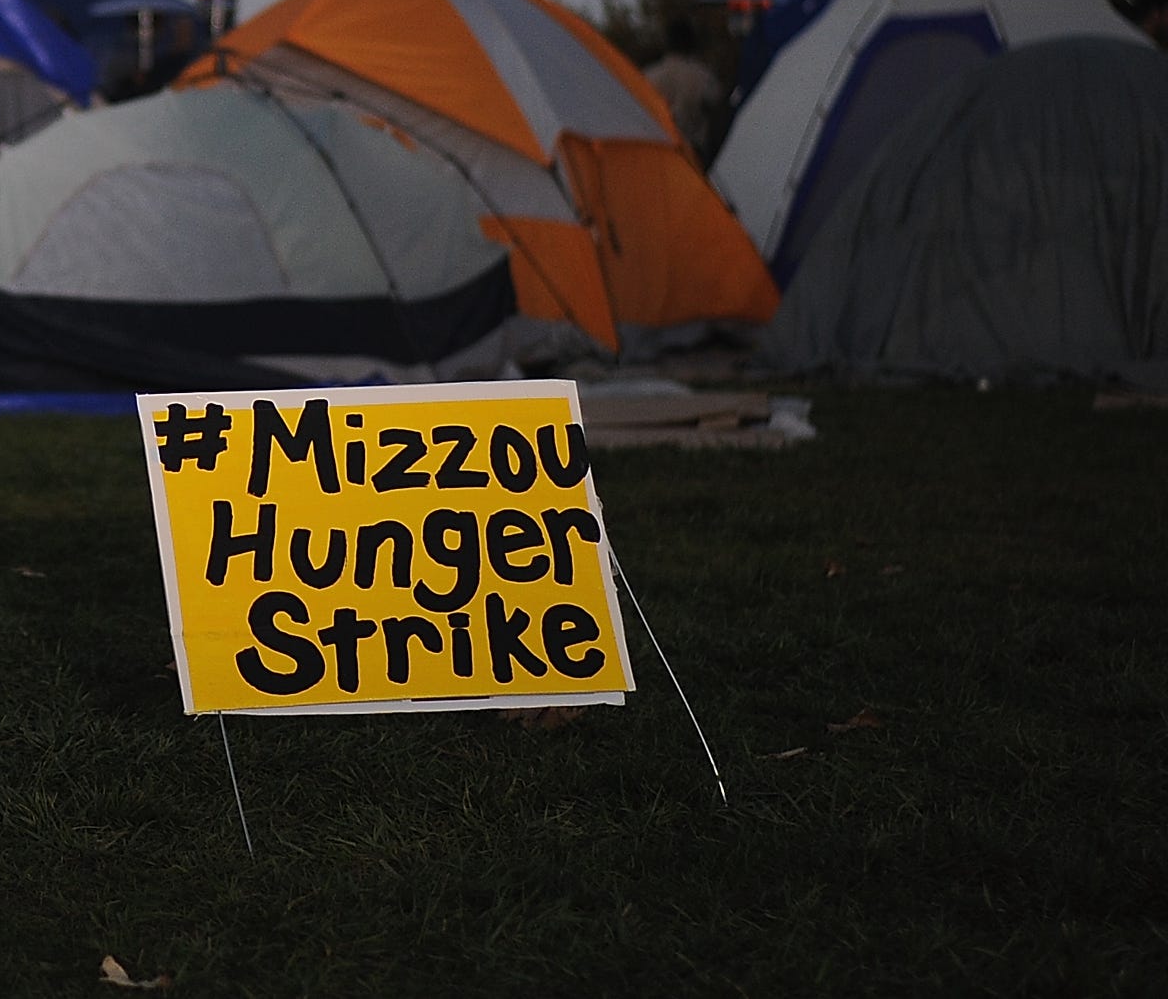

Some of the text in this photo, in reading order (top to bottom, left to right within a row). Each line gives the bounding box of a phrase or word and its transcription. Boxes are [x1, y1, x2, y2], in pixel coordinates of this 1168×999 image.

[153, 398, 591, 498] #Mizzou
[205, 500, 602, 613] Hunger
[235, 591, 607, 696] Strike
